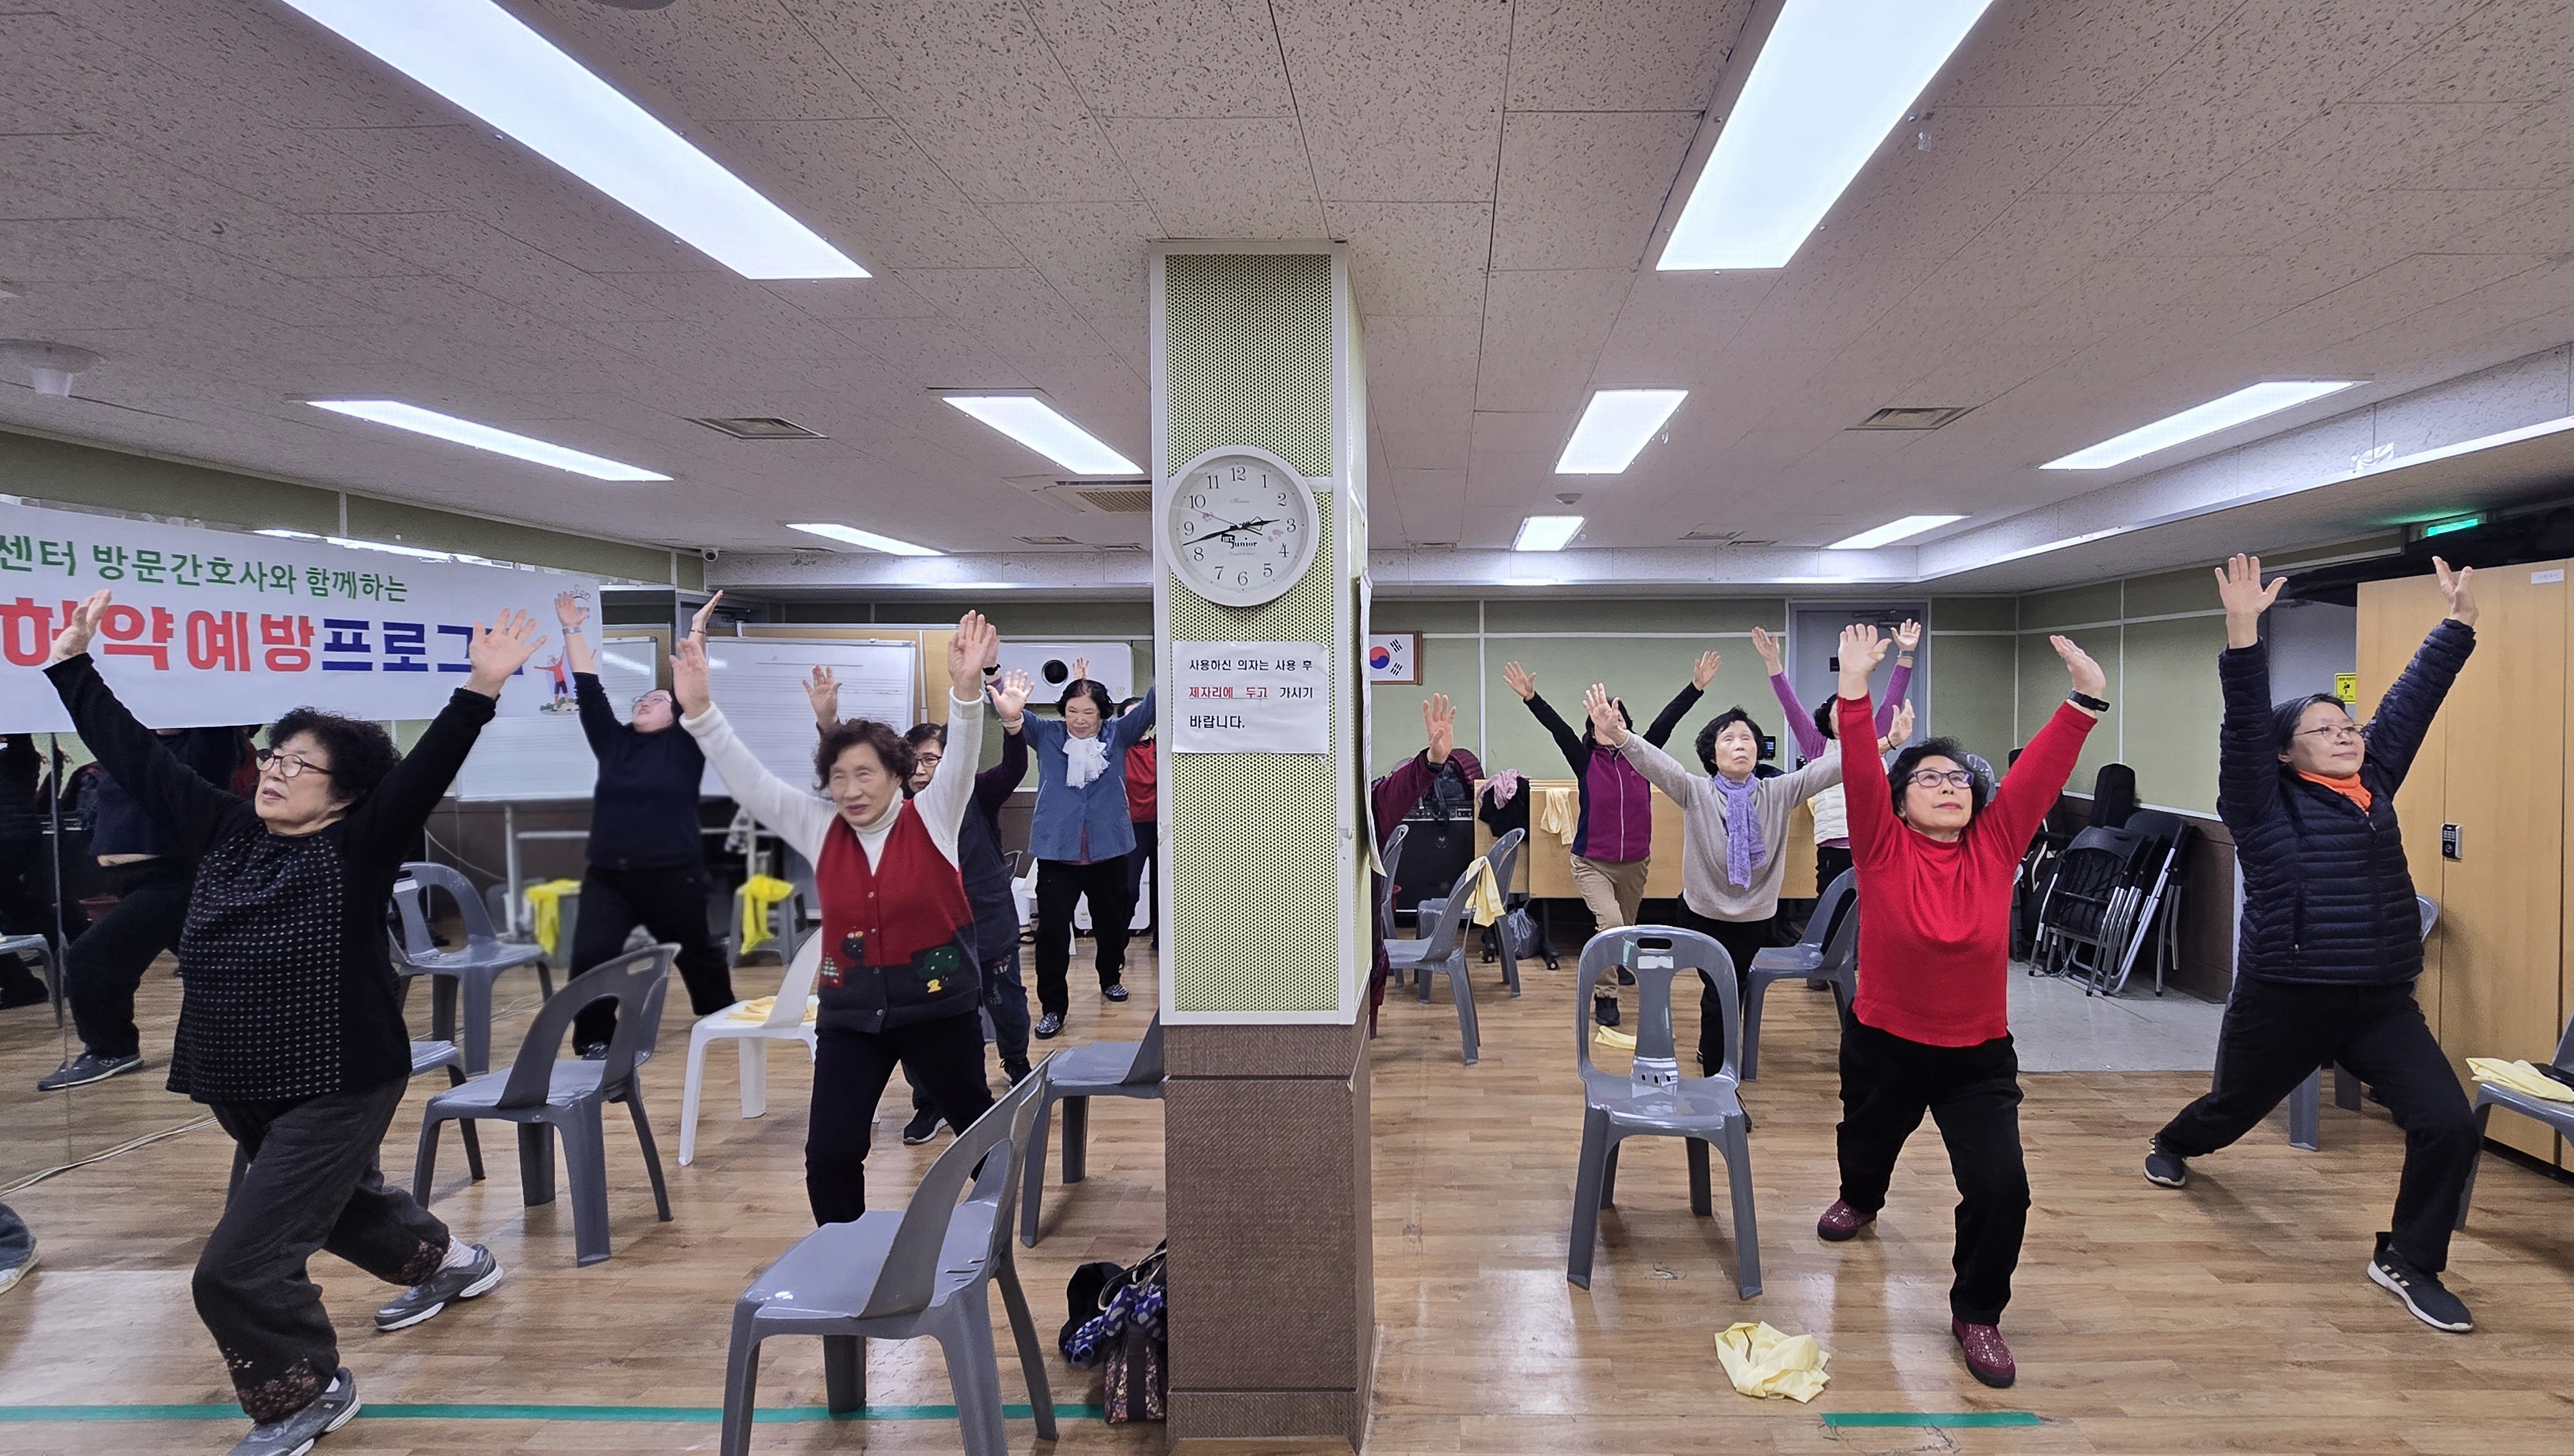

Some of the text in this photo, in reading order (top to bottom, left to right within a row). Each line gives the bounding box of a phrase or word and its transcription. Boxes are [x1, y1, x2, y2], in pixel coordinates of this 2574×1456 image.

[1231, 467, 1246, 481] 12
[1262, 474, 1267, 488] 1
[1207, 476, 1220, 489] 11
[1190, 494, 1206, 508] 10
[1277, 493, 1287, 506] 2
[1184, 521, 1194, 536] 9
[1287, 518, 1296, 532] 3
[1194, 547, 1204, 561] 8
[1279, 543, 1289, 558] 4
[0, 535, 408, 602] 센터 방문간호사와 함께하는
[1214, 566, 1224, 580] 7
[1263, 563, 1272, 577] 5
[1237, 571, 1248, 586] 6
[1189, 659, 1312, 671] 사용하신 의자는 사용 후
[1189, 687, 1313, 699] 제자리에 두고 가시기
[1189, 715, 1245, 729] 바랍니다.
